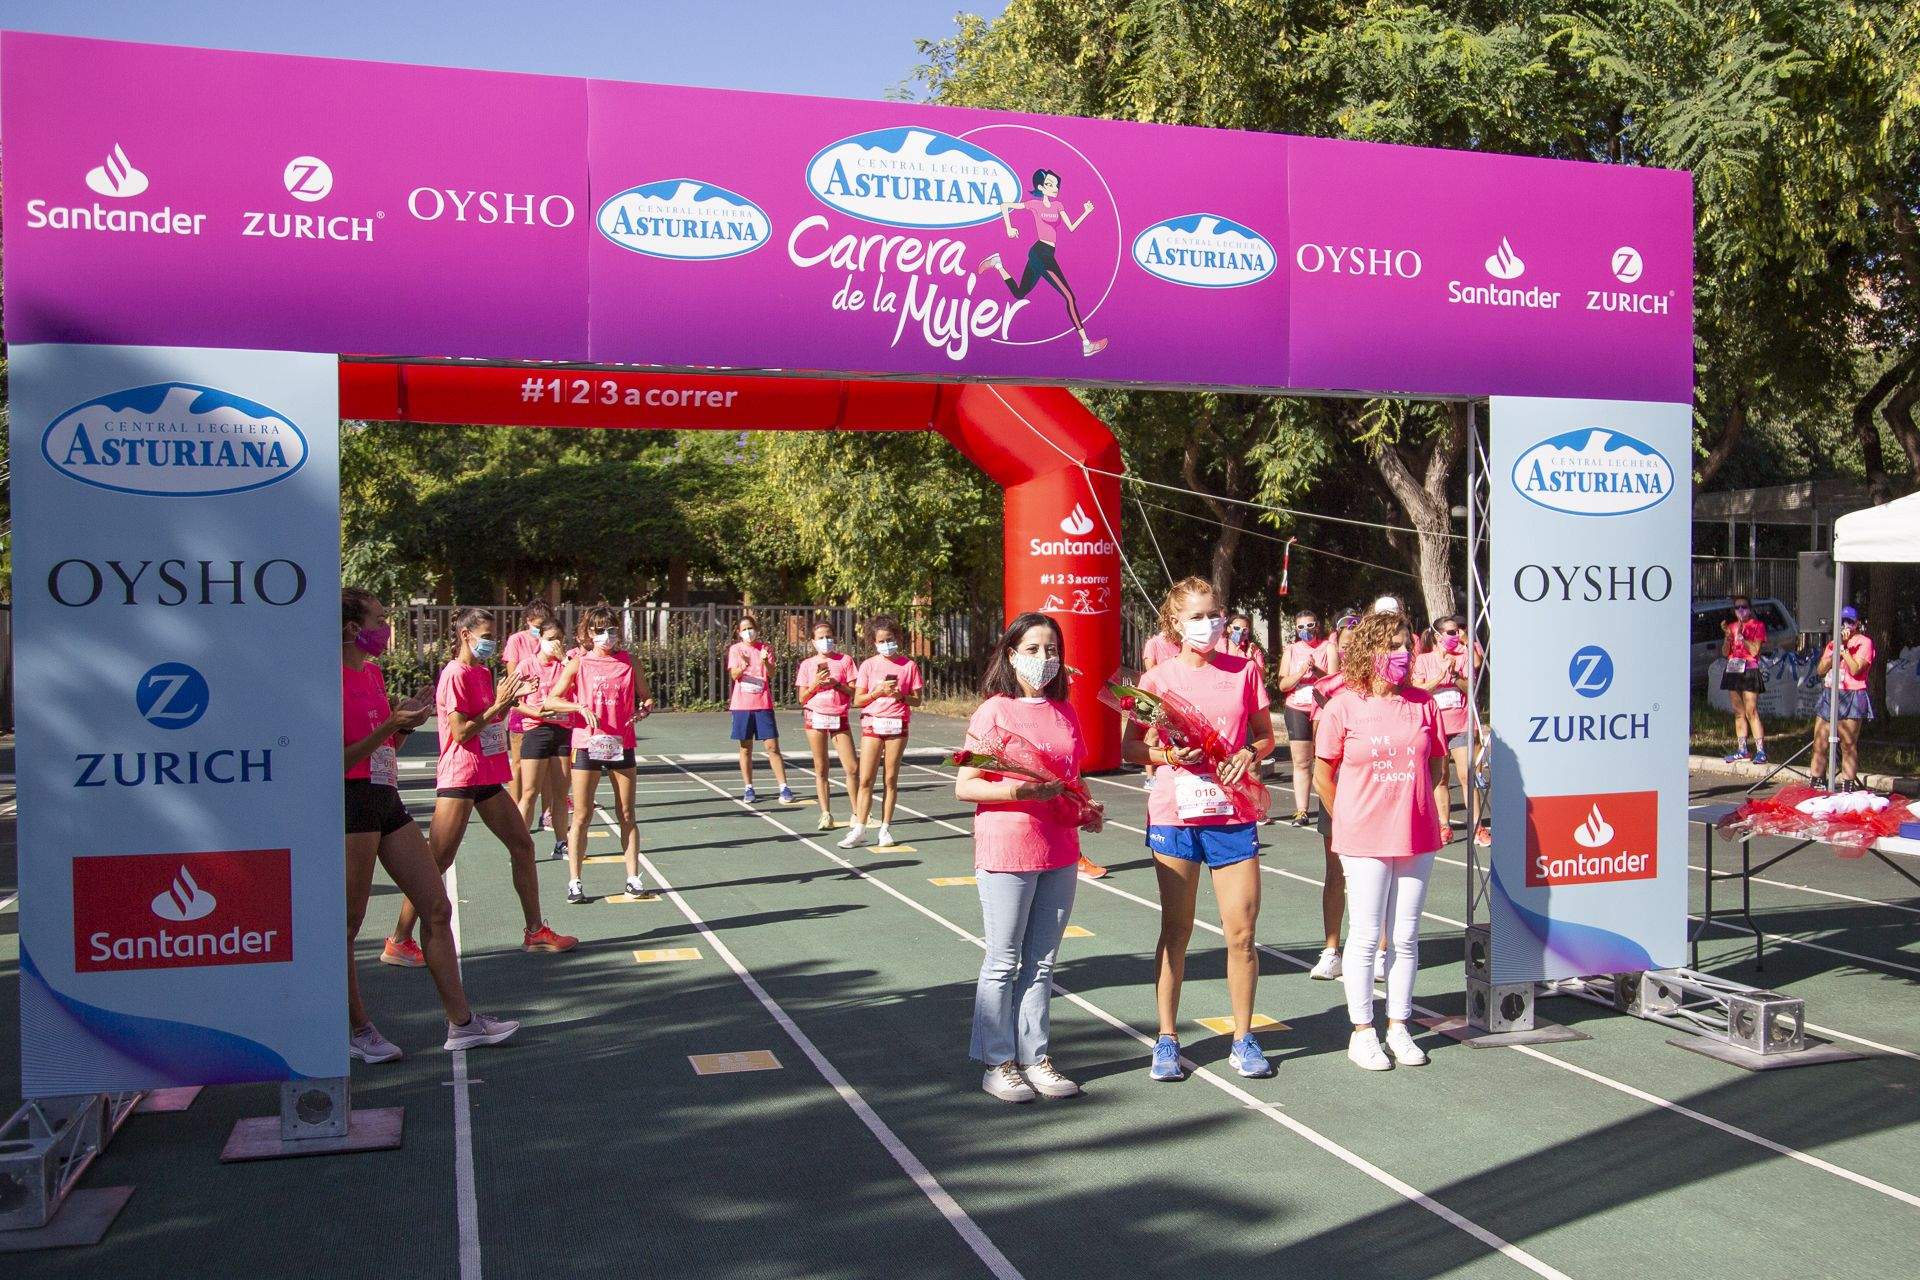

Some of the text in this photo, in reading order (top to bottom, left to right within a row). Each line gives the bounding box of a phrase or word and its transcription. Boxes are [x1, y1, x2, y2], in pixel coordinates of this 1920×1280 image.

[824, 158, 1004, 206] ASTURIANA
[857, 158, 998, 177] CENTRAL LECHERA
[27, 199, 206, 235] Santander
[407, 186, 576, 228] OYSHO
[611, 205, 758, 241] ASTURIANA
[638, 205, 753, 218] CENTRAL LECHERA
[787, 215, 967, 277] Carrera
[1145, 237, 1265, 271] ASTURIANA
[1296, 243, 1422, 279] OYSHO
[1448, 280, 1561, 309] Santander
[832, 272, 1031, 361] de la Mujer
[62, 423, 288, 468] ASTURIANA
[104, 421, 280, 435] CENTRAL LECHERA
[1525, 458, 1663, 494] ASTURIANA
[1551, 457, 1659, 469] CENTRAL LECHERA
[1030, 538, 1114, 556] Santander
[47, 558, 307, 608] OYSHO
[1513, 564, 1672, 603] OYSHO
[1370, 735, 1391, 745] WE
[1372, 759, 1415, 770] FOR A
[1372, 772, 1416, 782] REASON
[1535, 851, 1649, 879] Santander
[90, 926, 277, 962] Santander
